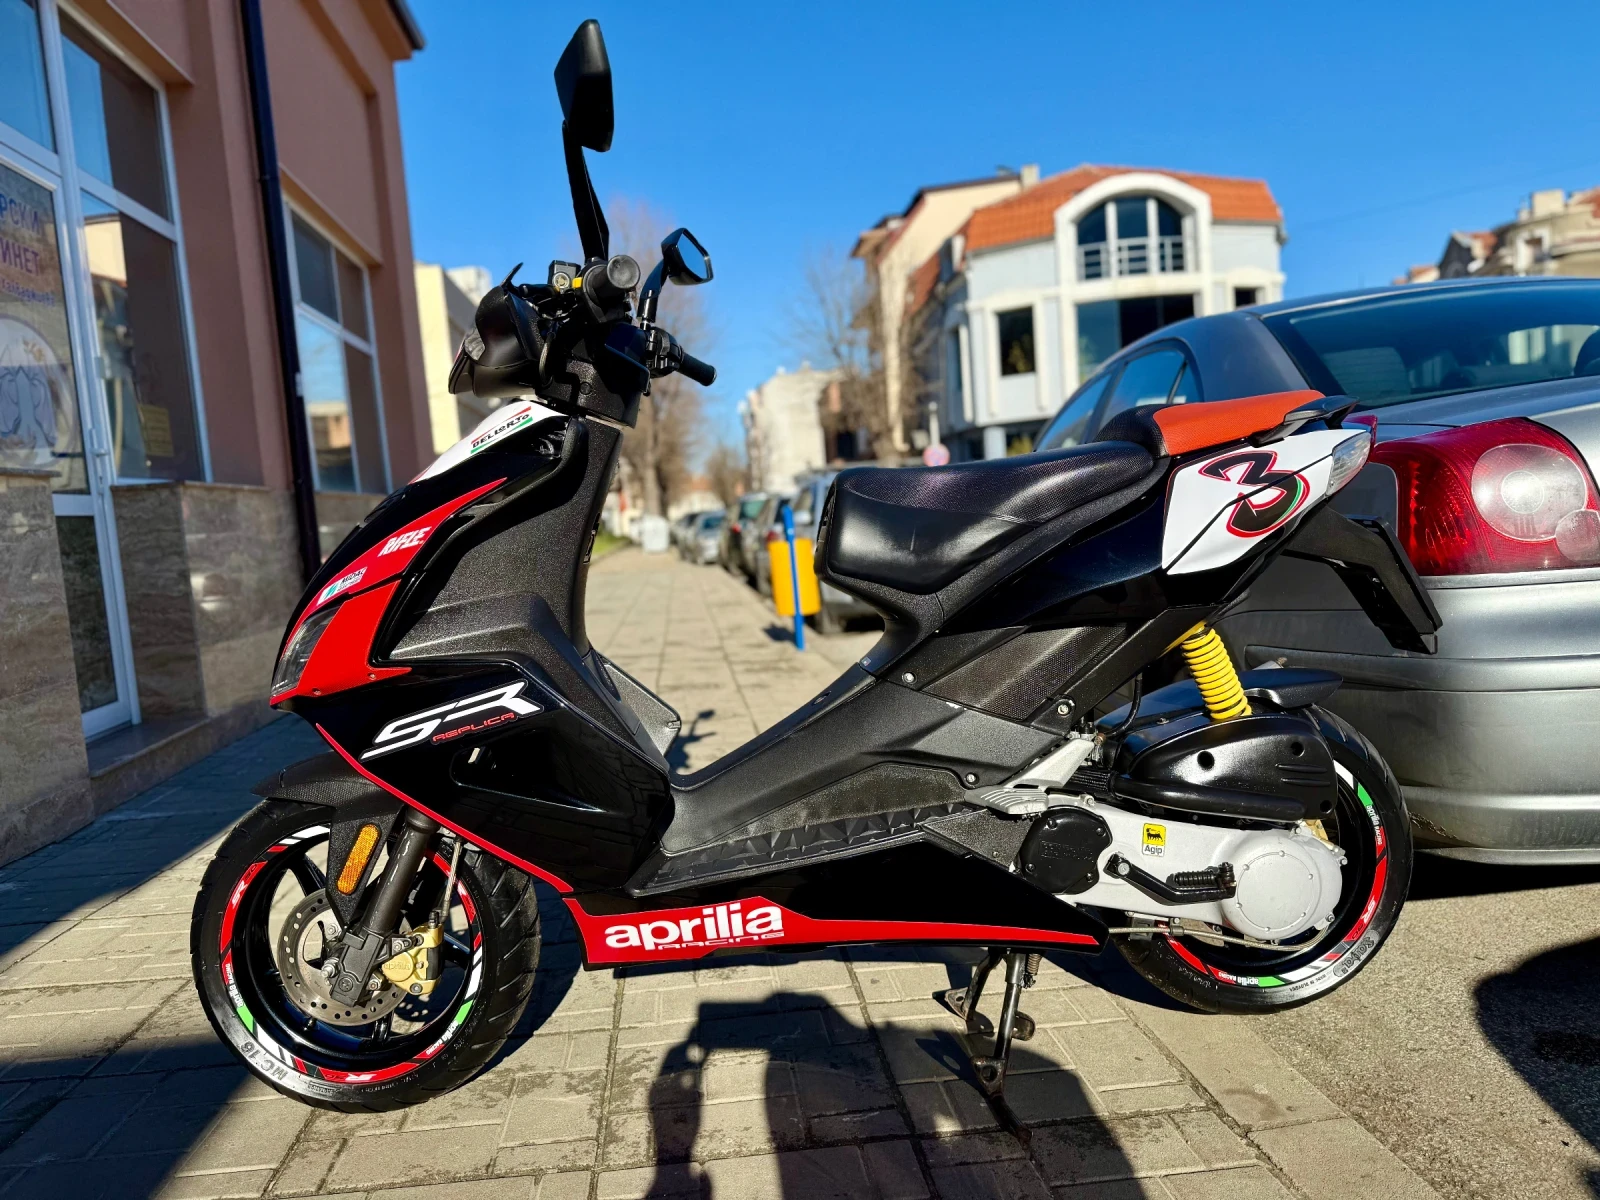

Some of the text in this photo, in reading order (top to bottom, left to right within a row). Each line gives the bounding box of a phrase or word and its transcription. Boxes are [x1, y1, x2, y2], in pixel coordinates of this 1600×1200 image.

[1198, 450, 1310, 538] 3
[360, 681, 541, 760] SR
[432, 712, 515, 742] REPLICA
[1144, 844, 1163, 856] Agip
[604, 902, 784, 951] aprilia
